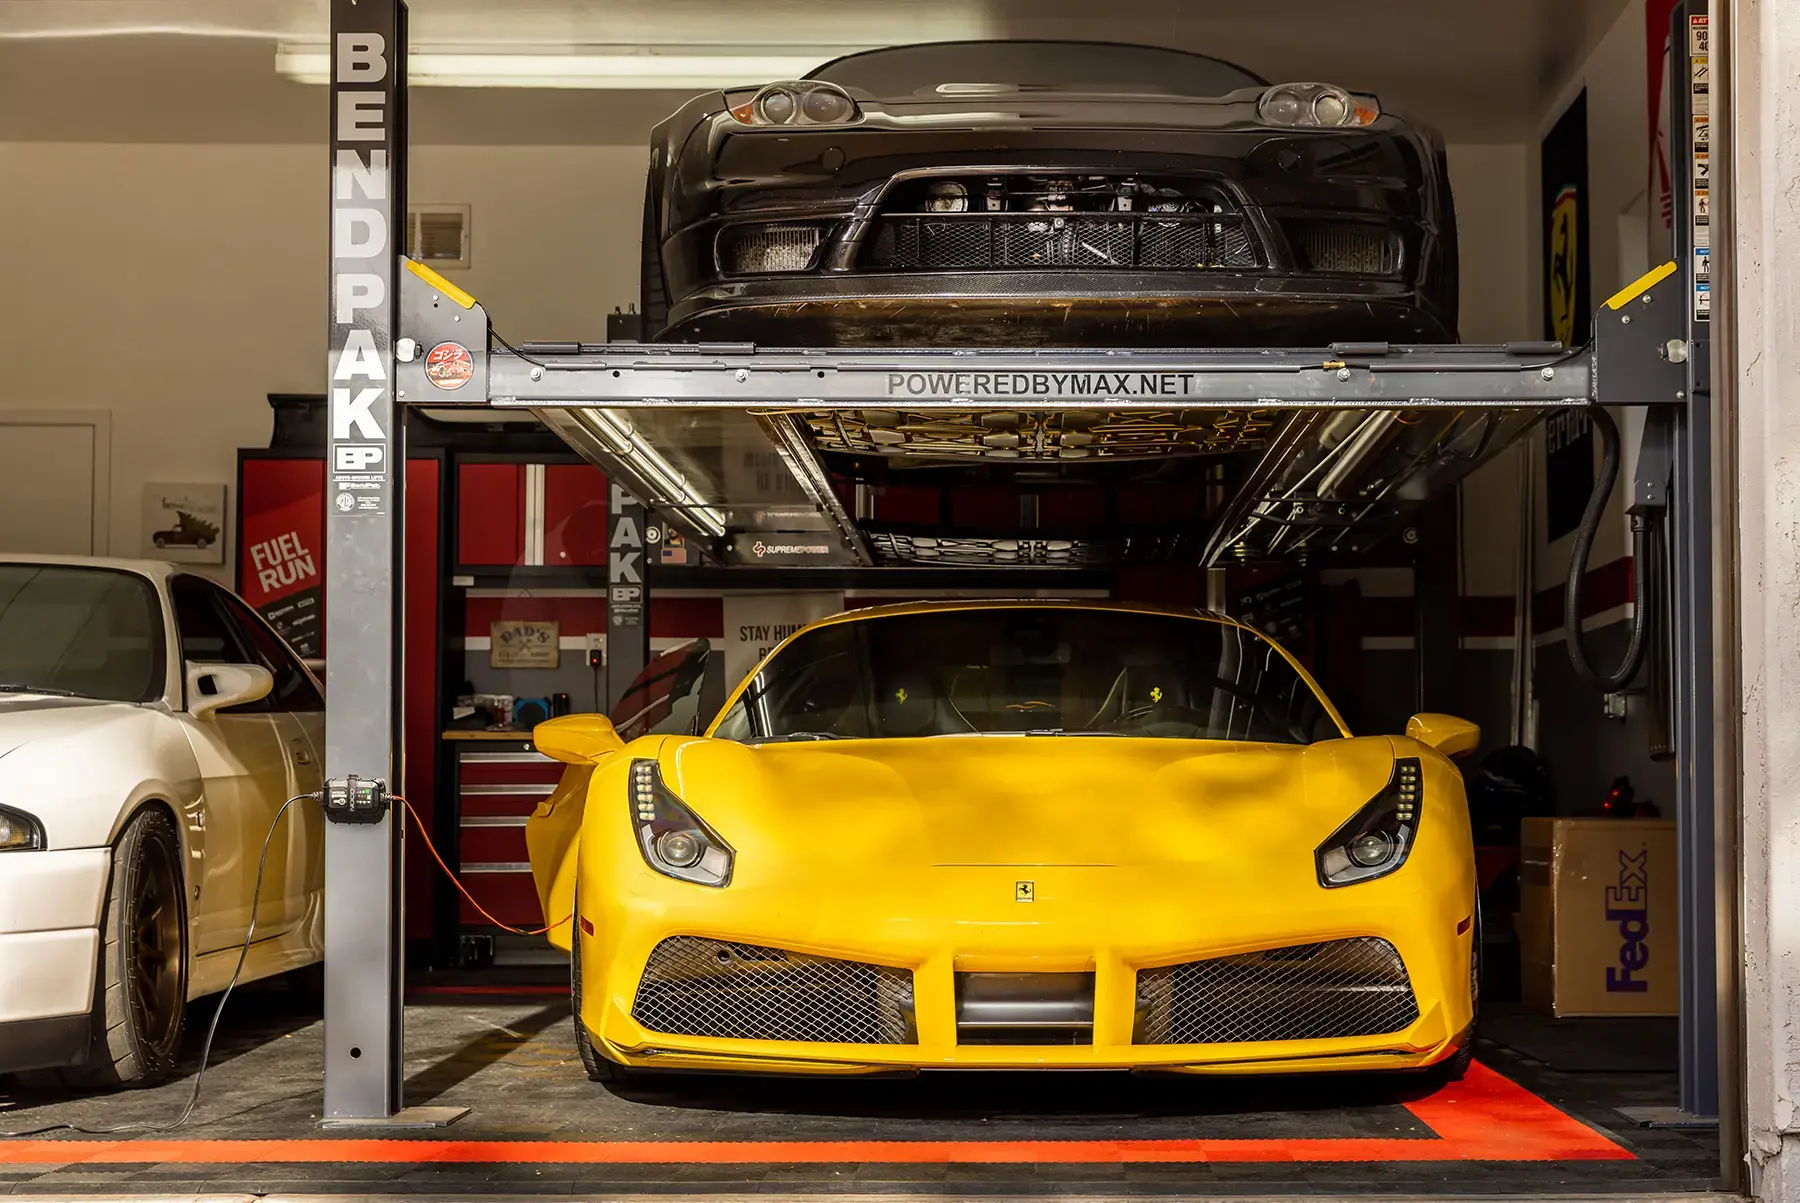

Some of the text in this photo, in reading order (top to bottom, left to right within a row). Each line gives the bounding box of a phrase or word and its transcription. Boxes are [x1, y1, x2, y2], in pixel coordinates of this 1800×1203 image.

[333, 32, 388, 439] BENDPAK
[888, 373, 1195, 396] POWEREDBYMAX.NET
[336, 447, 383, 470] BP
[250, 531, 309, 571] FUEL
[258, 553, 317, 594] RUN
[612, 587, 641, 601] BP
[740, 625, 770, 642] STAY
[1605, 849, 1650, 993] FedEx
